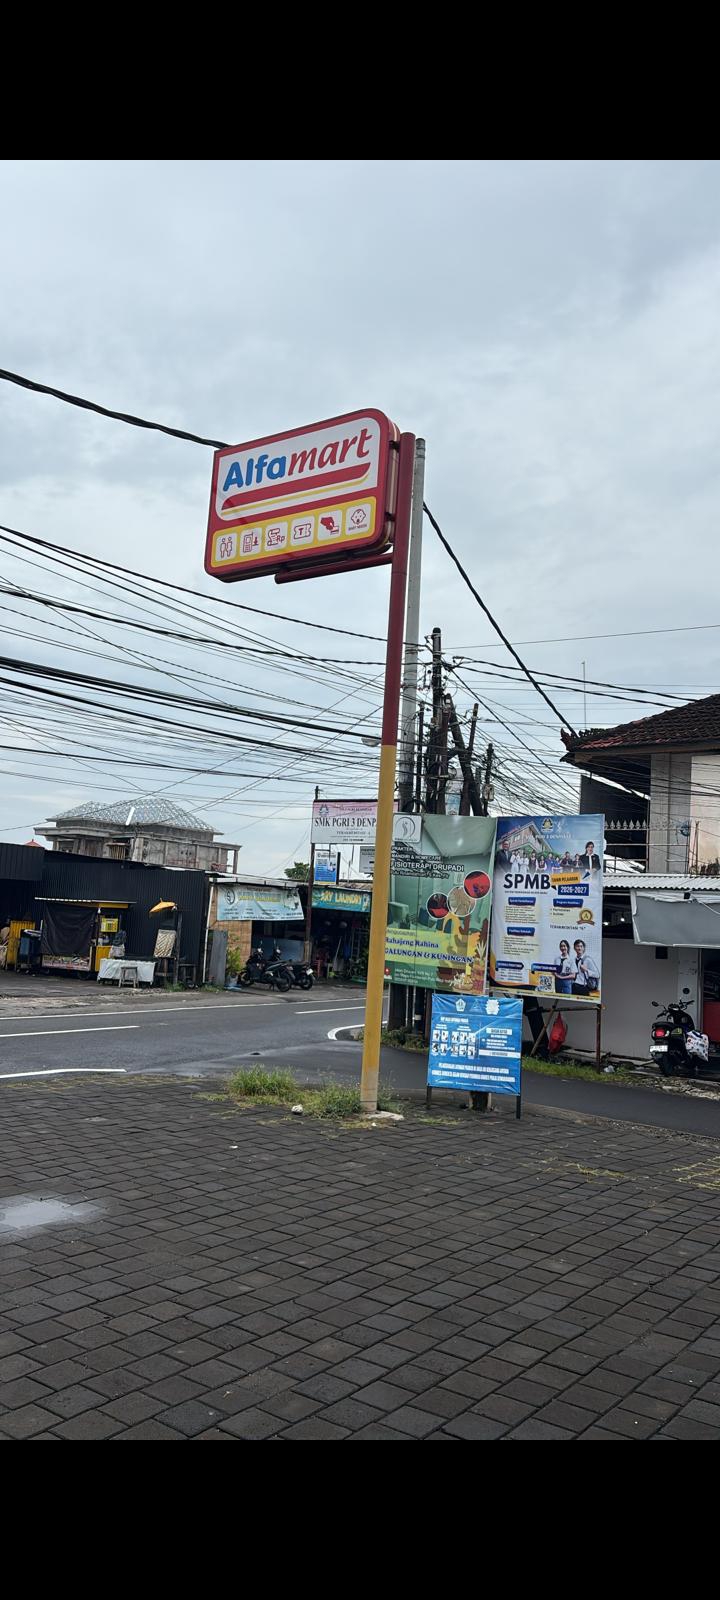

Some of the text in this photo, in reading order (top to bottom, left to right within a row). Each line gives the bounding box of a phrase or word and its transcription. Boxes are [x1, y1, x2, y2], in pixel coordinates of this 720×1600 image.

[222, 428, 373, 492] Alfamart
[314, 817, 377, 828] SMK PGRI 3 DENP
[391, 861, 465, 872] FISIOTERAPI DRUPADI
[503, 873, 551, 890] SPMB
[560, 885, 588, 894] 2026-2027
[415, 940, 439, 949] Rahina
[385, 948, 423, 958] GALUNGAN
